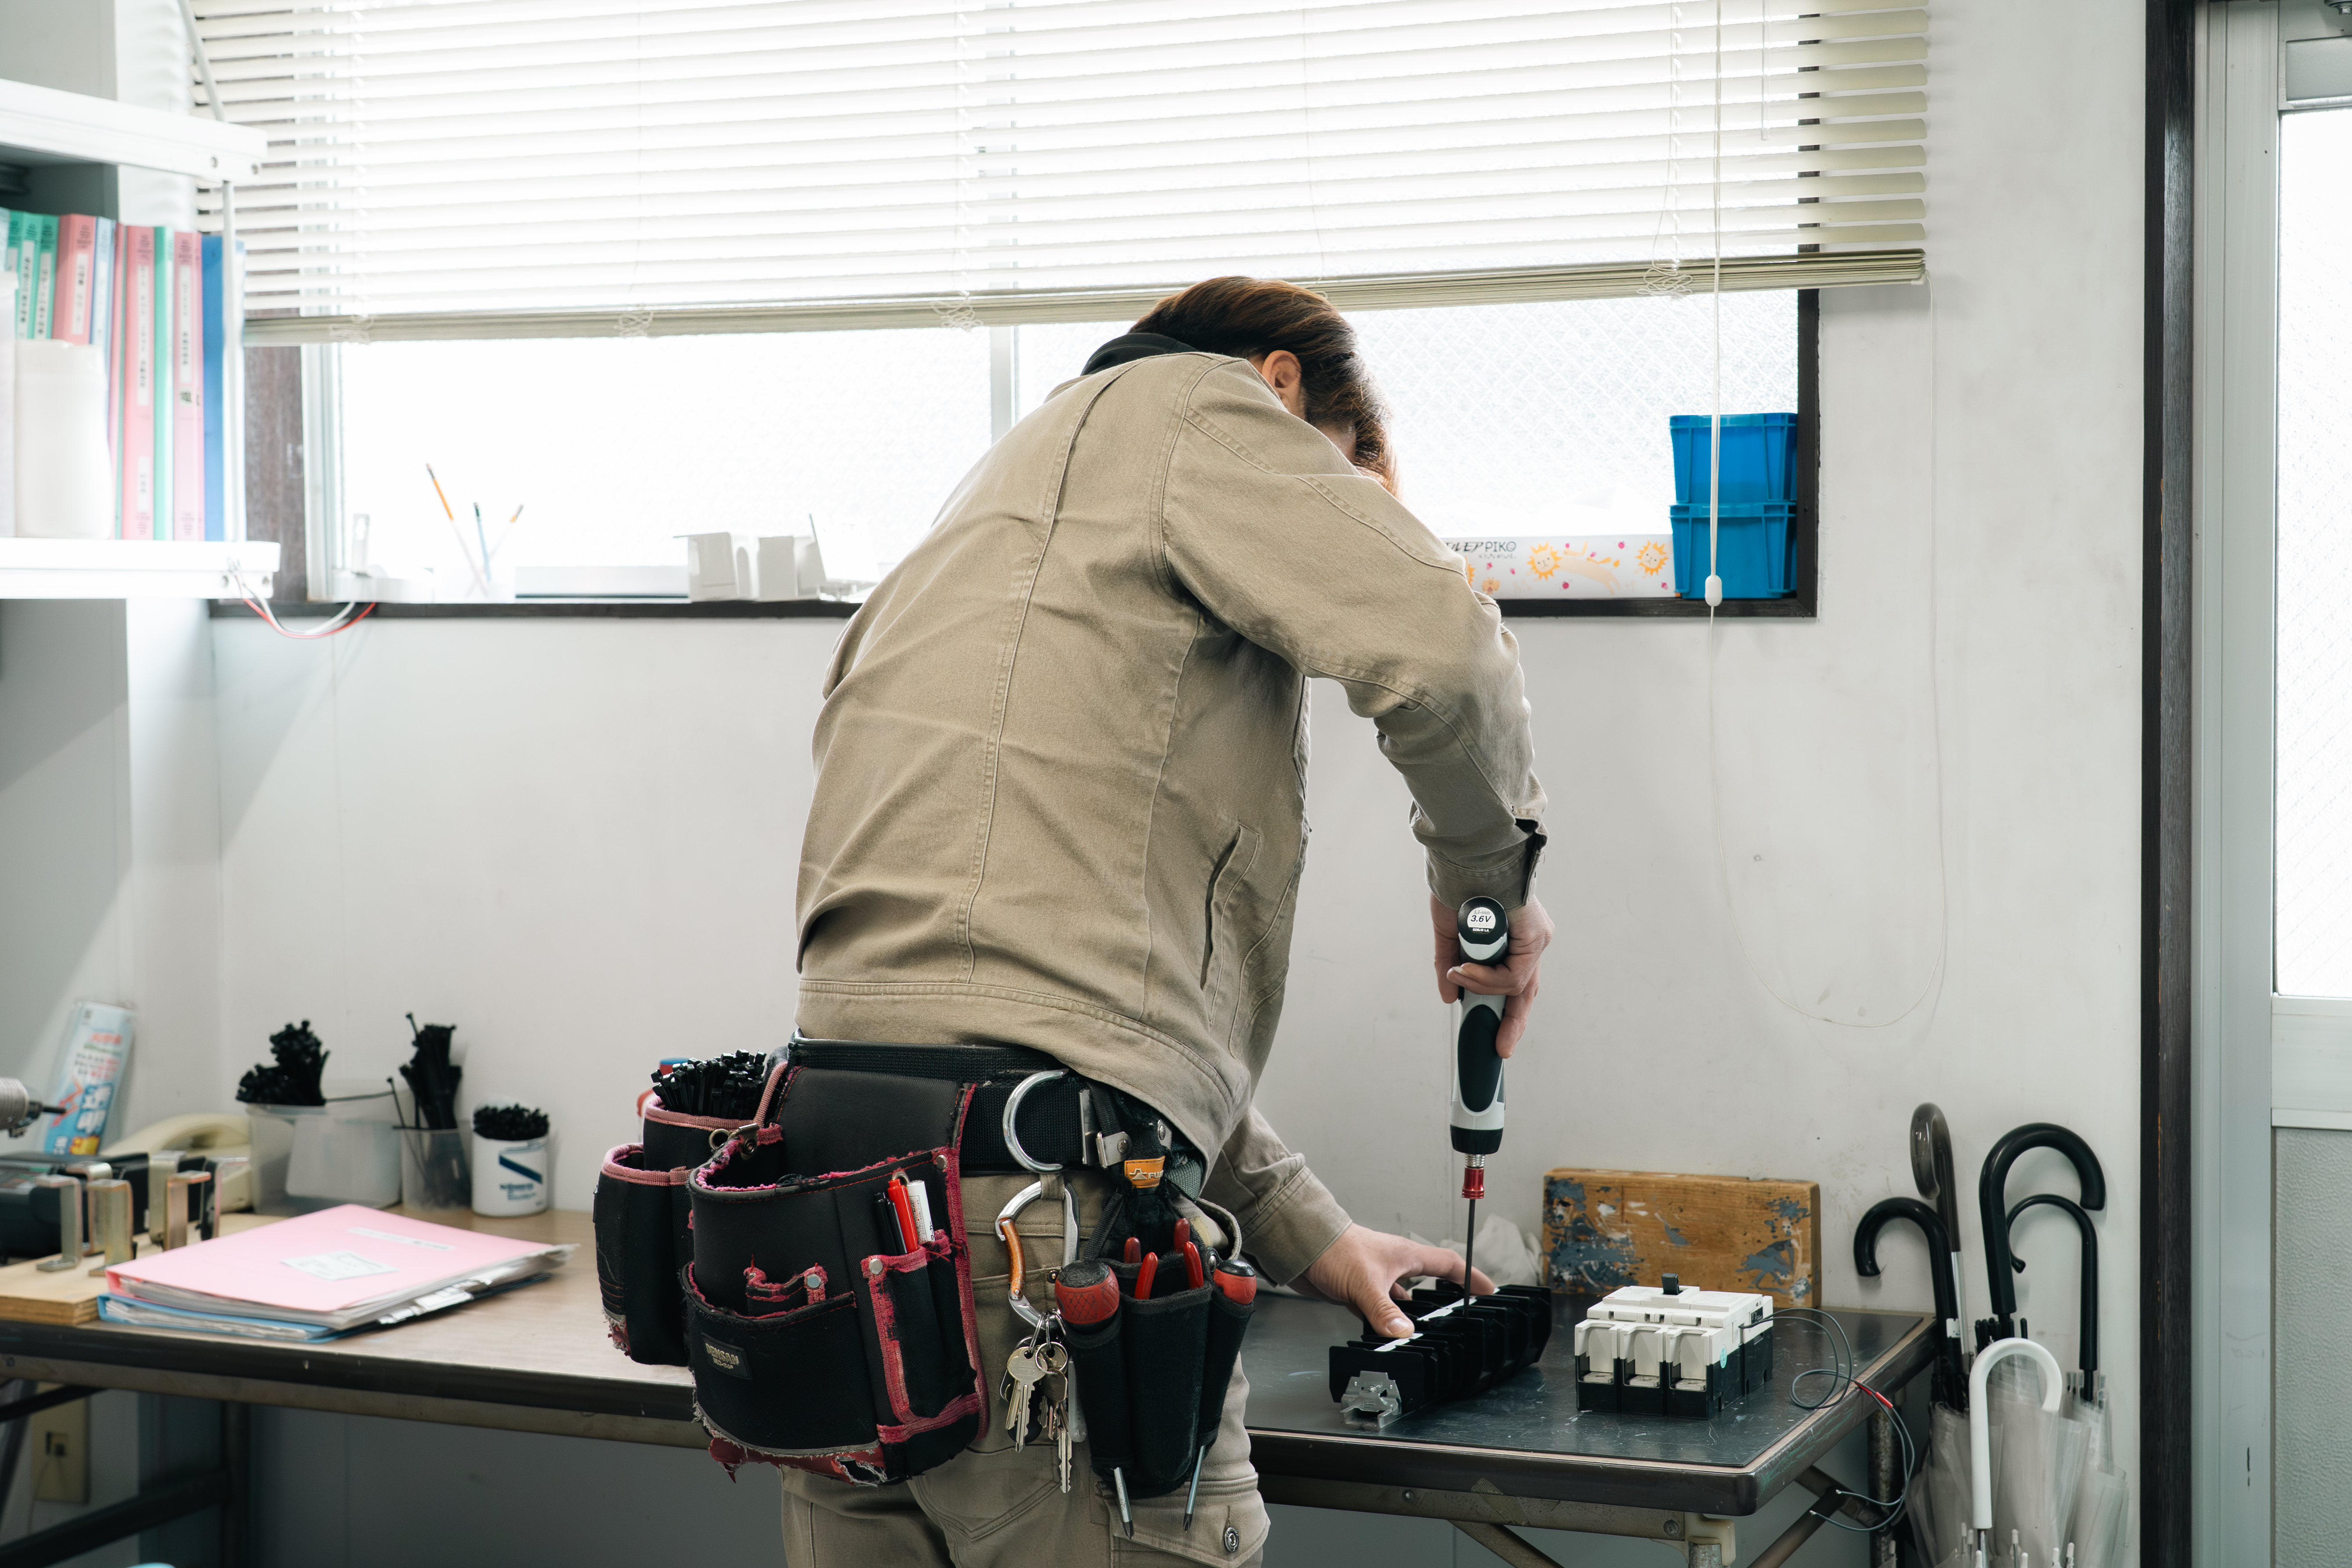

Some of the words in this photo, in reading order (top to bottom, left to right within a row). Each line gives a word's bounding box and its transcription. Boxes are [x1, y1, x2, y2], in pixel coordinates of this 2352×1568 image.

[1446, 542, 1484, 553] ルモア
[1485, 541, 1516, 552] PIKO
[705, 1343, 739, 1366] DENSAN
